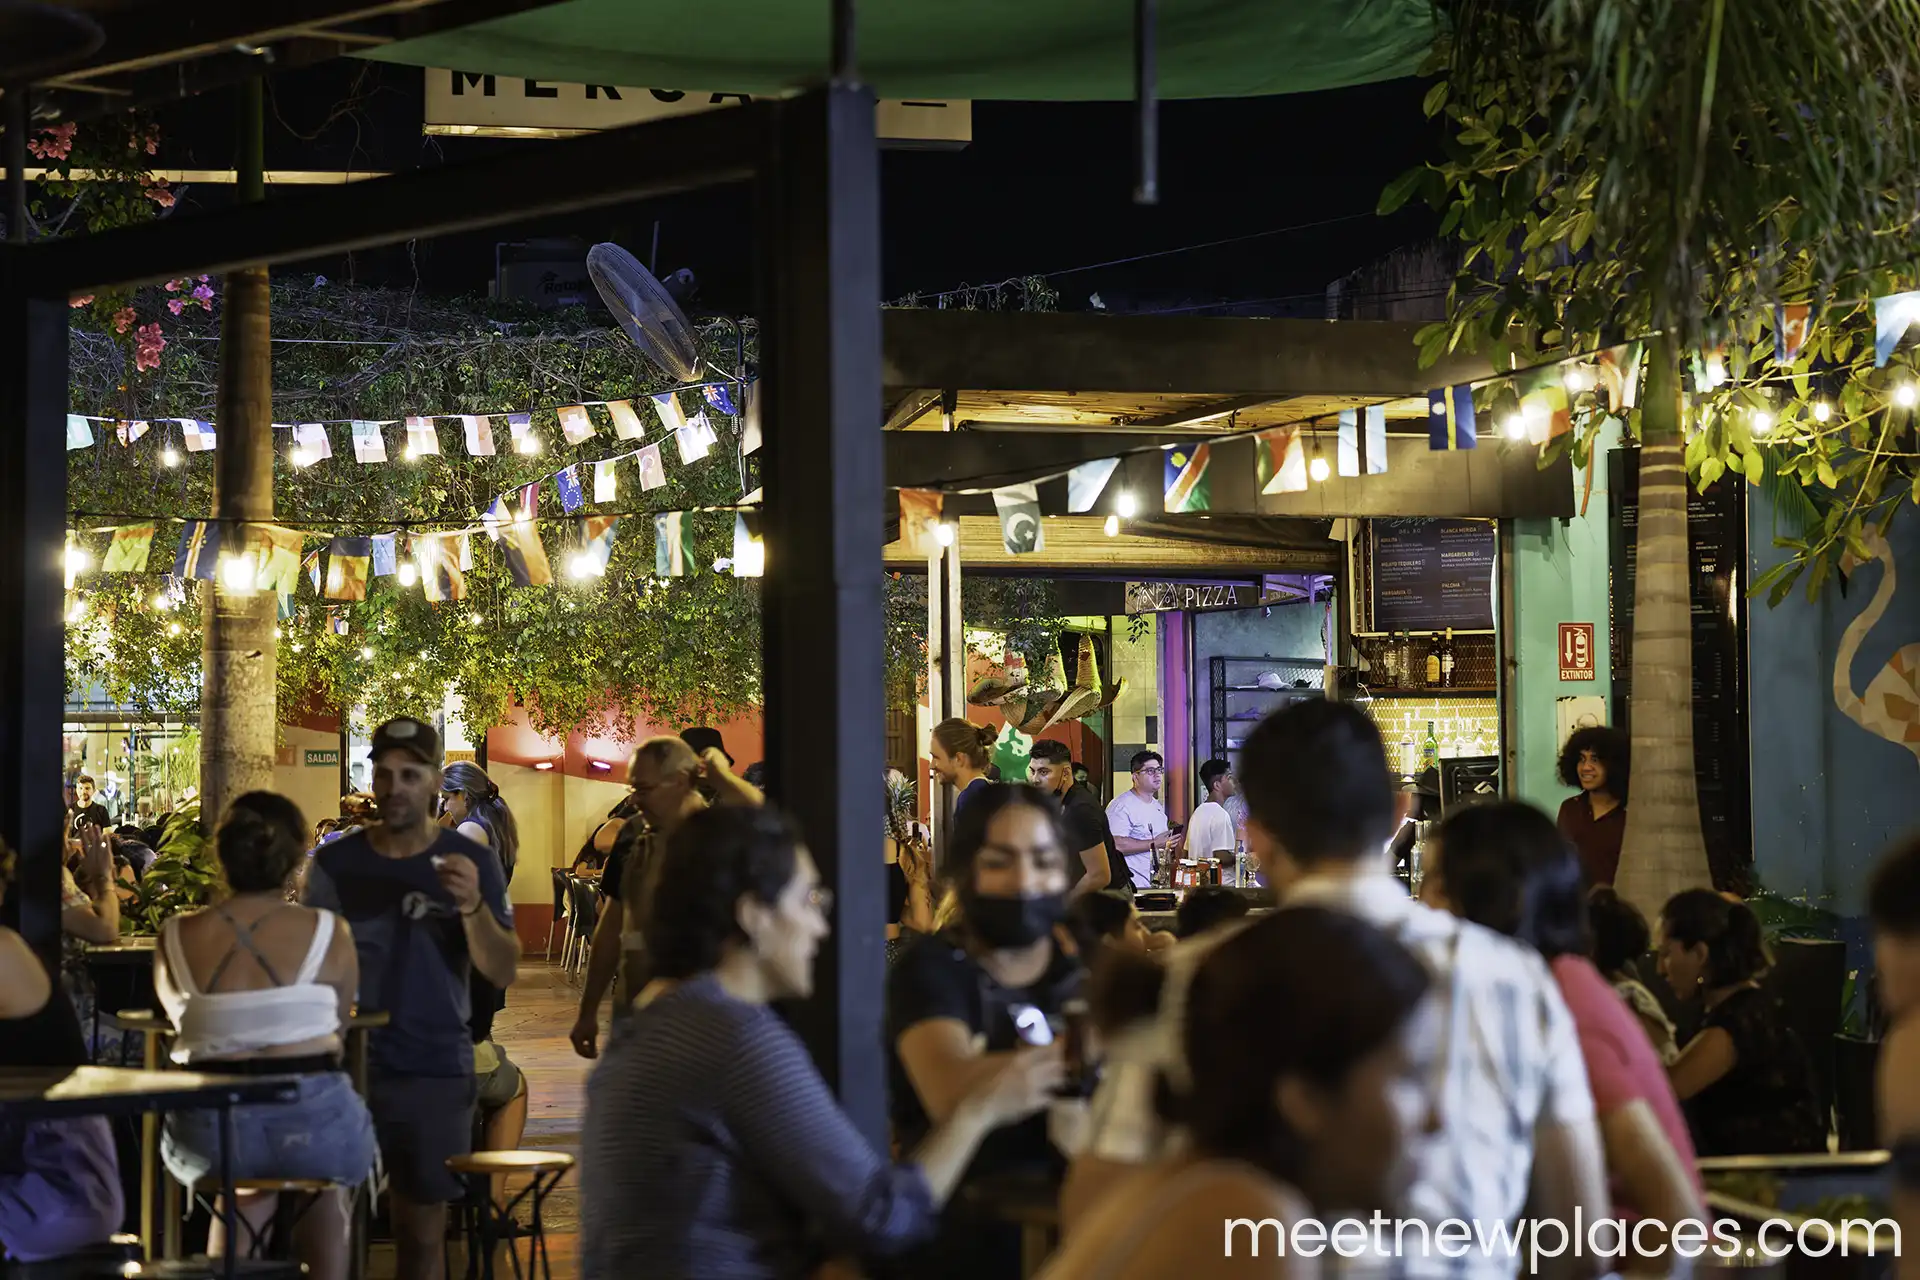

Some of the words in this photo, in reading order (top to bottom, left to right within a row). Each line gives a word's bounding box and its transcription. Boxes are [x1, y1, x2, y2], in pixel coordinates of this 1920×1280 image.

[1184, 585, 1238, 608] PIZZA
[1561, 670, 1594, 680] EXTINTOR
[307, 753, 338, 763] SALIDA
